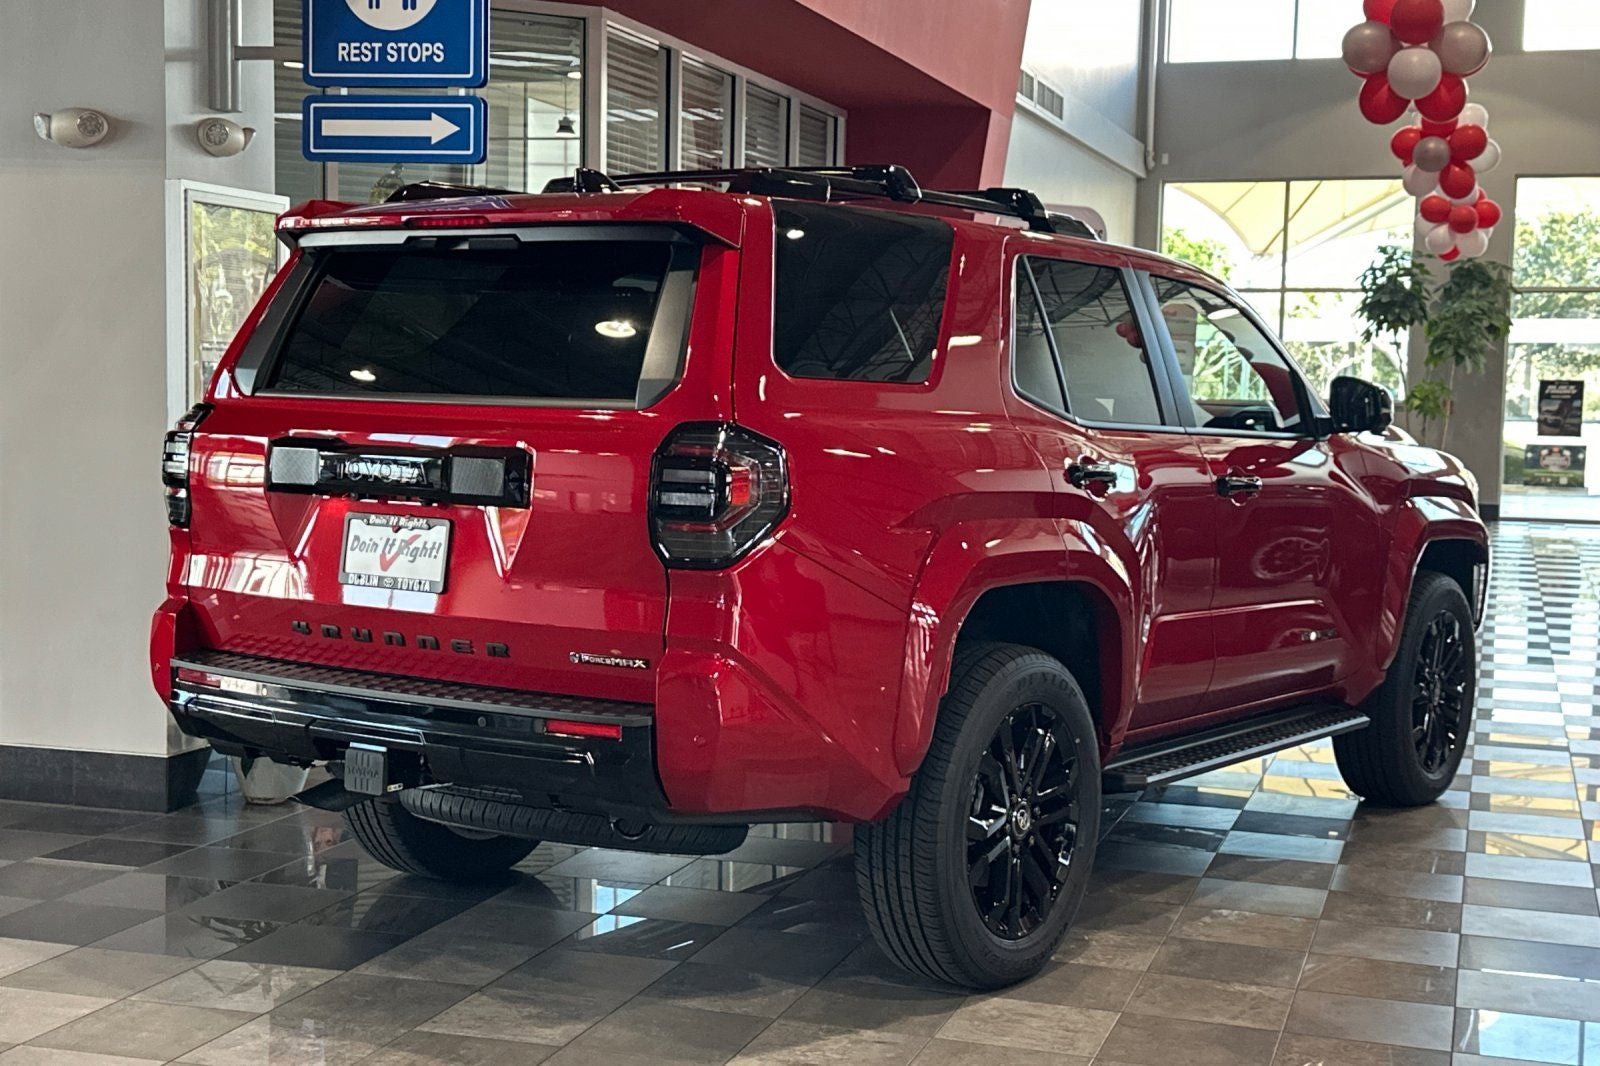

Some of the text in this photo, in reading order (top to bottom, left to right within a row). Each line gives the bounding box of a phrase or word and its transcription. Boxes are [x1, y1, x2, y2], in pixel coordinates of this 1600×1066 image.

[338, 42, 444, 62] REST STOPS
[334, 459, 428, 484] TOYOTA
[381, 537, 396, 555] It
[399, 539, 442, 563] Right!
[348, 573, 431, 592] DUBLIN TOYOTA
[291, 620, 511, 658] 4RUNNER
